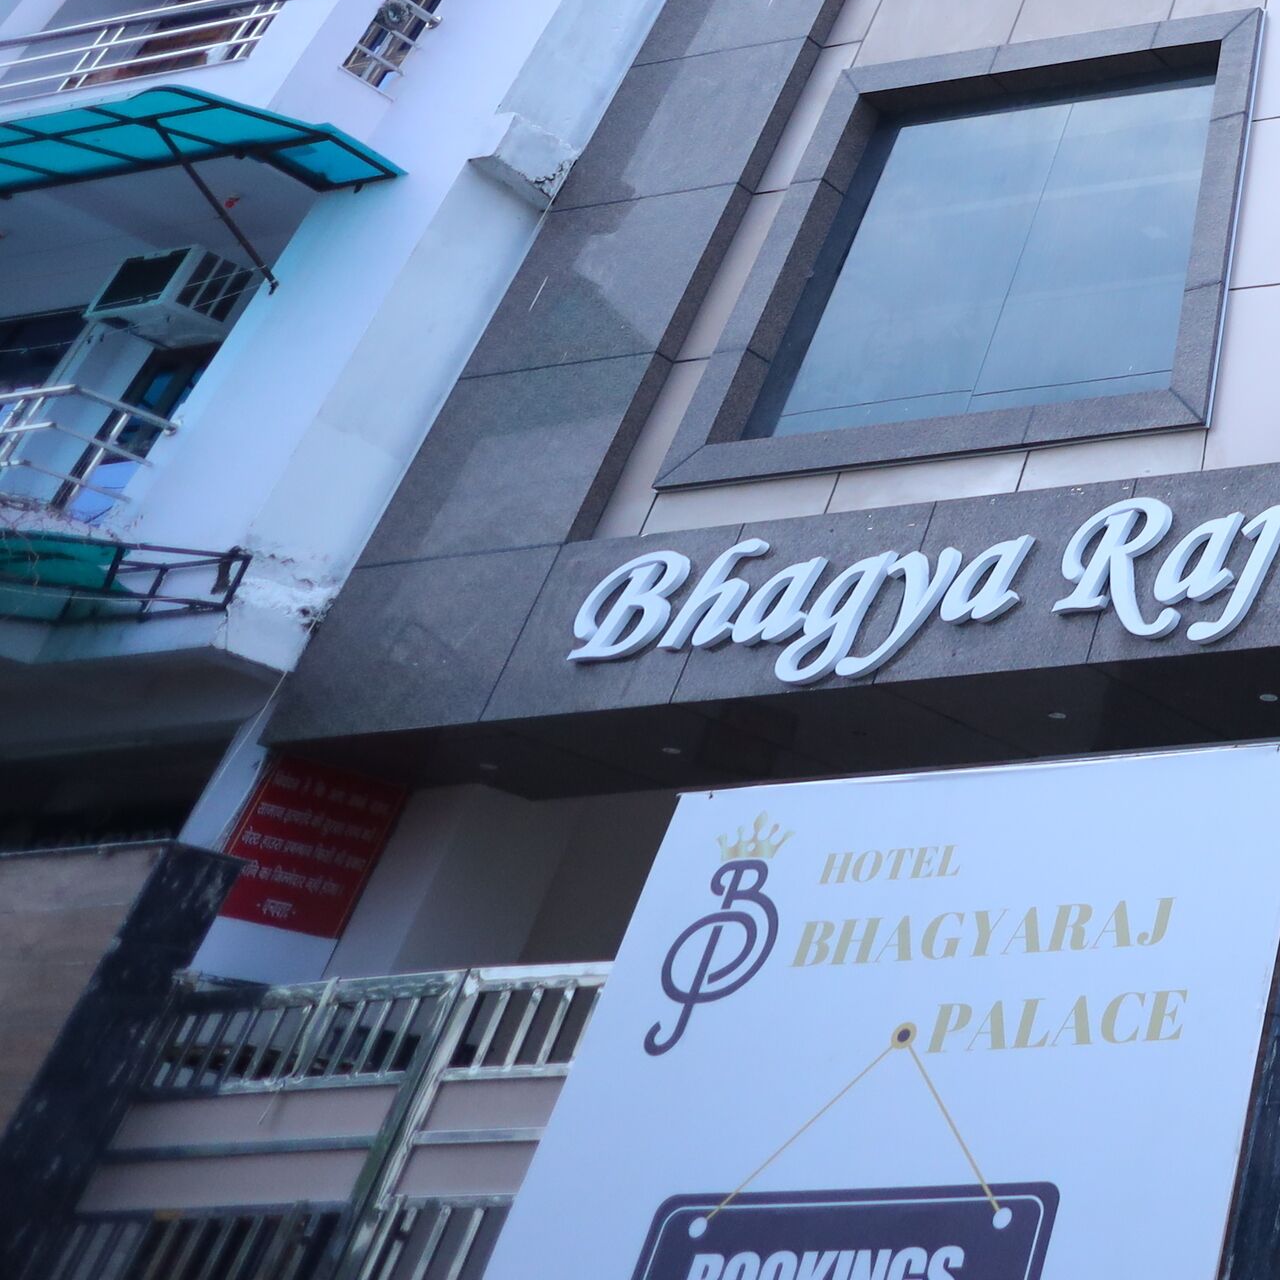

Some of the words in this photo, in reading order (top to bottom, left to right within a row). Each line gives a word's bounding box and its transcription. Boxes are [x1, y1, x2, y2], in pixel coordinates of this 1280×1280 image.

[567, 538, 1036, 685] Bhagya
[819, 844, 961, 885] HOTEL
[791, 897, 1177, 968] BHAGYARAJ
[926, 989, 1188, 1054] PALACE
